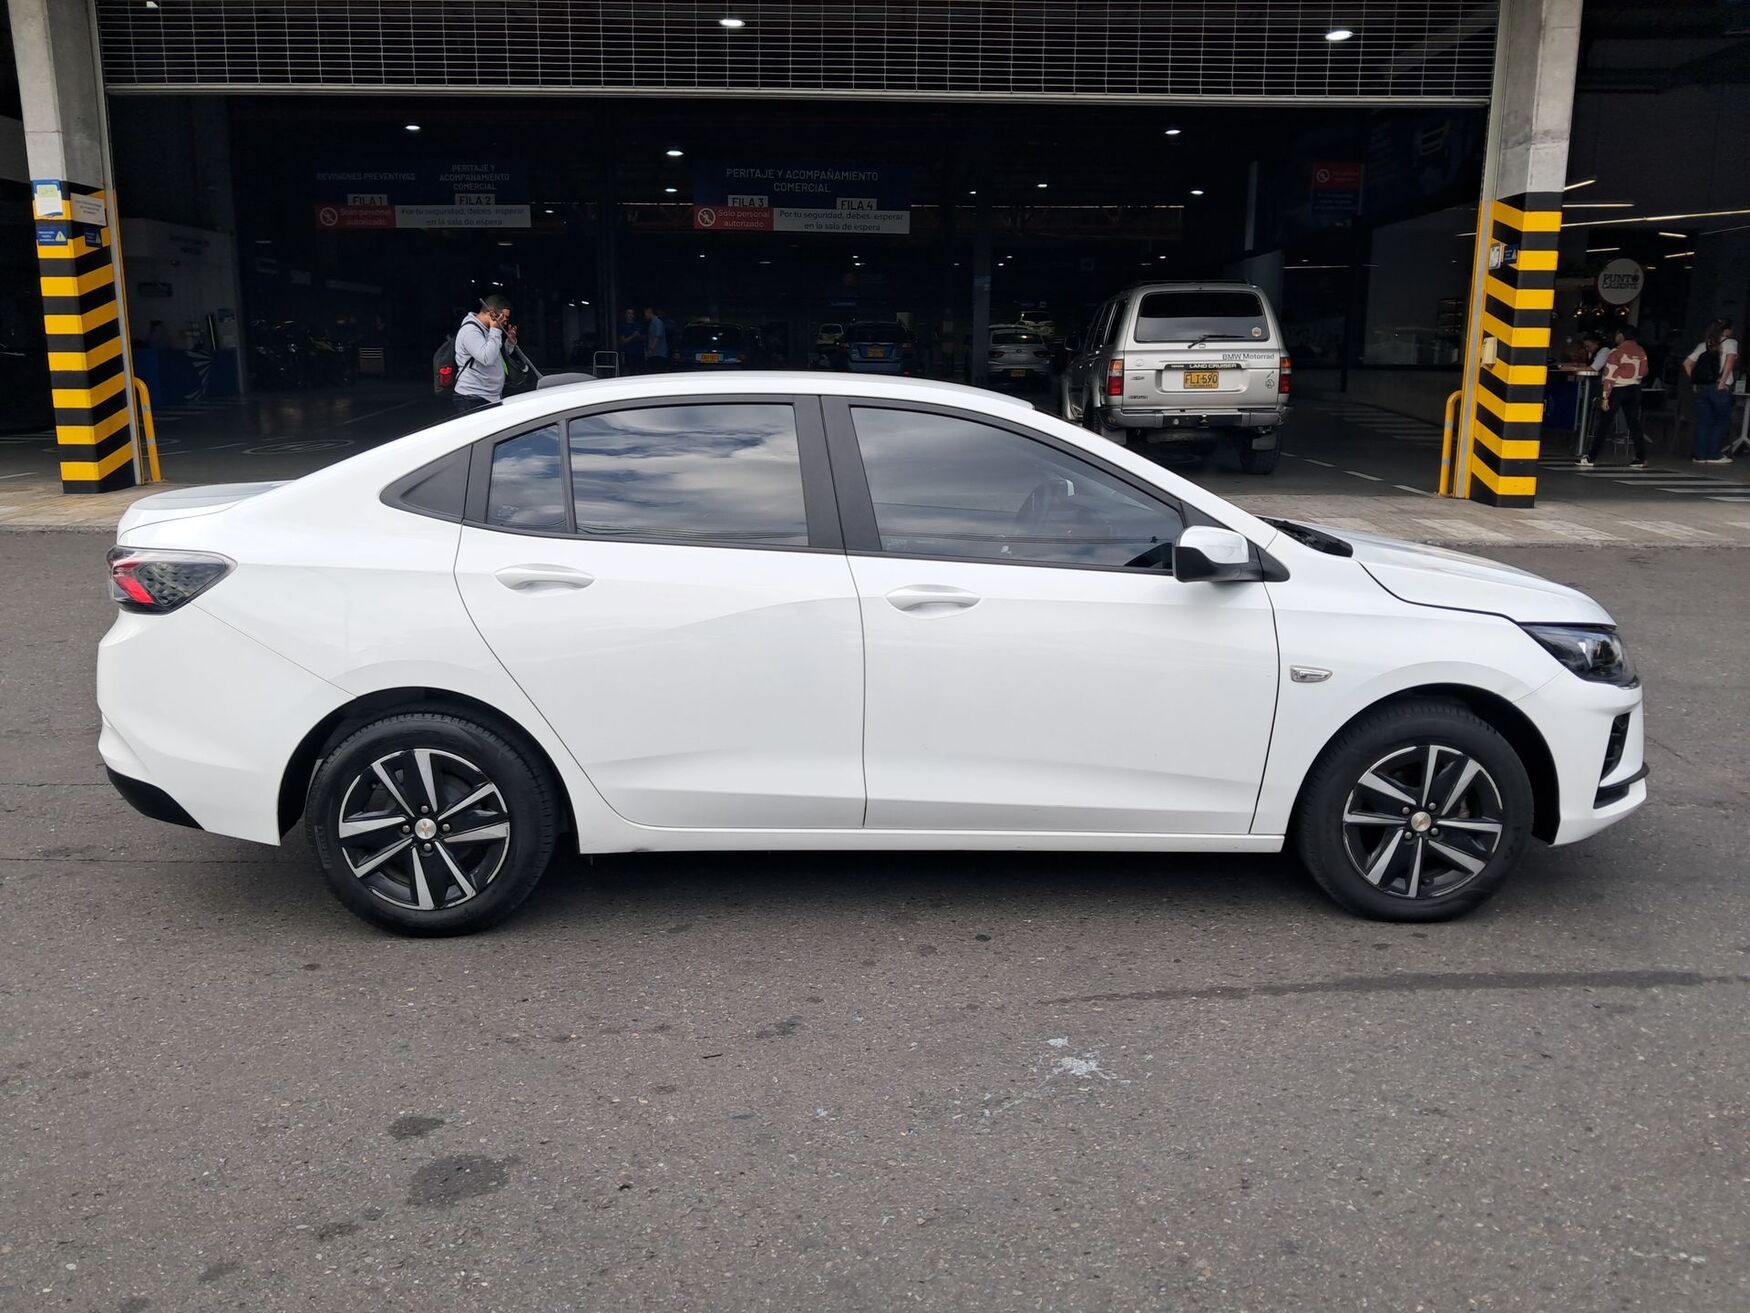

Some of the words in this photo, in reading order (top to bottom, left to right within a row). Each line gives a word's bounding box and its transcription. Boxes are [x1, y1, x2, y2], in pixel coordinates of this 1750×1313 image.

[726, 168, 775, 179] PERITAJE
[777, 169, 784, 178] Y
[785, 168, 879, 181] ACOMPAÑAMIENTO
[453, 183, 497, 191] COMERCIAL
[773, 182, 831, 193] COMERCIAL
[352, 196, 376, 206] FILA
[459, 196, 482, 206] FILA
[486, 196, 492, 206] 2
[732, 197, 756, 207] FILA
[759, 197, 765, 207] 3
[841, 200, 864, 210] FILA
[867, 200, 873, 210] 4
[718, 209, 736, 218] Solo
[737, 210, 770, 220] personal
[779, 210, 793, 218] Por
[794, 210, 803, 218] tu
[874, 213, 904, 222] esperar
[725, 219, 765, 228] autorizado
[816, 222, 824, 230] la
[825, 222, 841, 230] sala
[842, 222, 853, 231] de
[854, 224, 881, 233] espera
[1603, 273, 1640, 283] PUNTO
